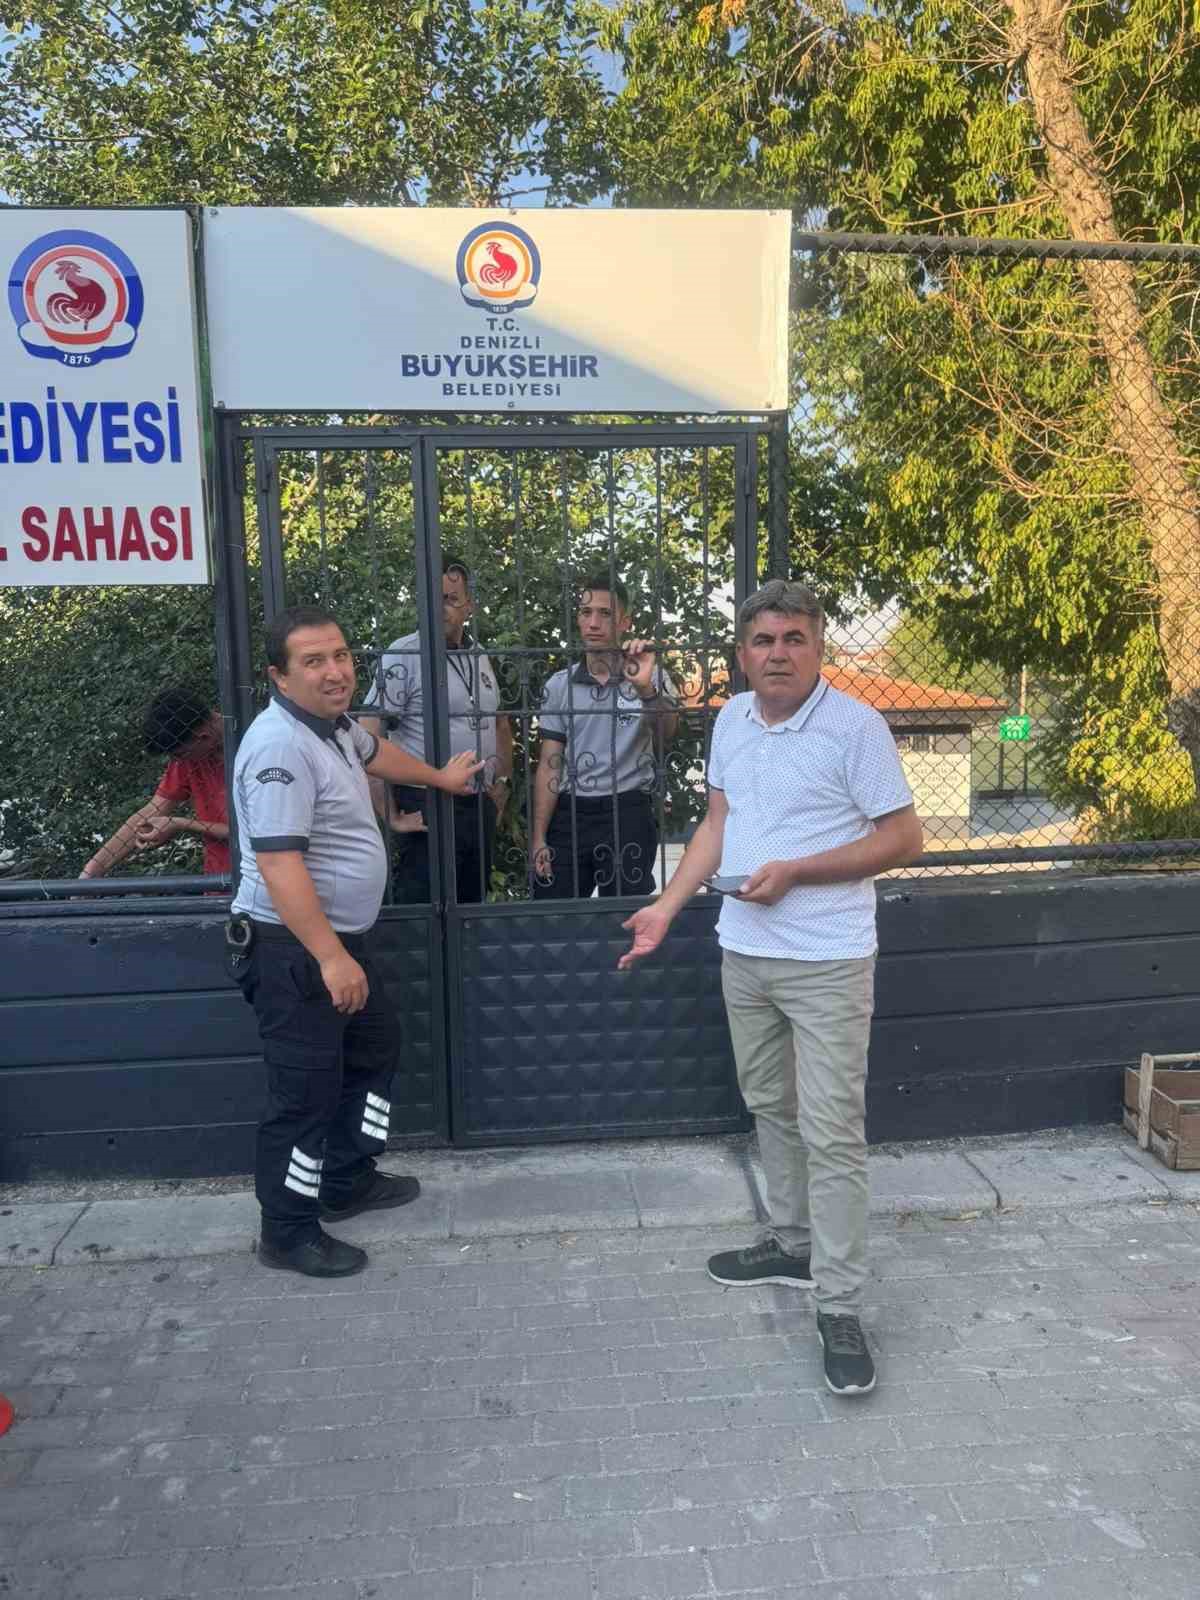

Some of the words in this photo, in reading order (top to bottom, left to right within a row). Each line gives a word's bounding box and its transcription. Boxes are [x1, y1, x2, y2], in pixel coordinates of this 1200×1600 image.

[486, 318, 519, 331] T.C.
[461, 336, 540, 349] DENİZLİ
[63, 352, 92, 365] 1876
[402, 354, 598, 379] BÜYÜKŞEHİR
[443, 383, 561, 396] BELEDİYESİ
[0, 386, 182, 464] DİYESİ
[21, 506, 193, 562] SAHASI
